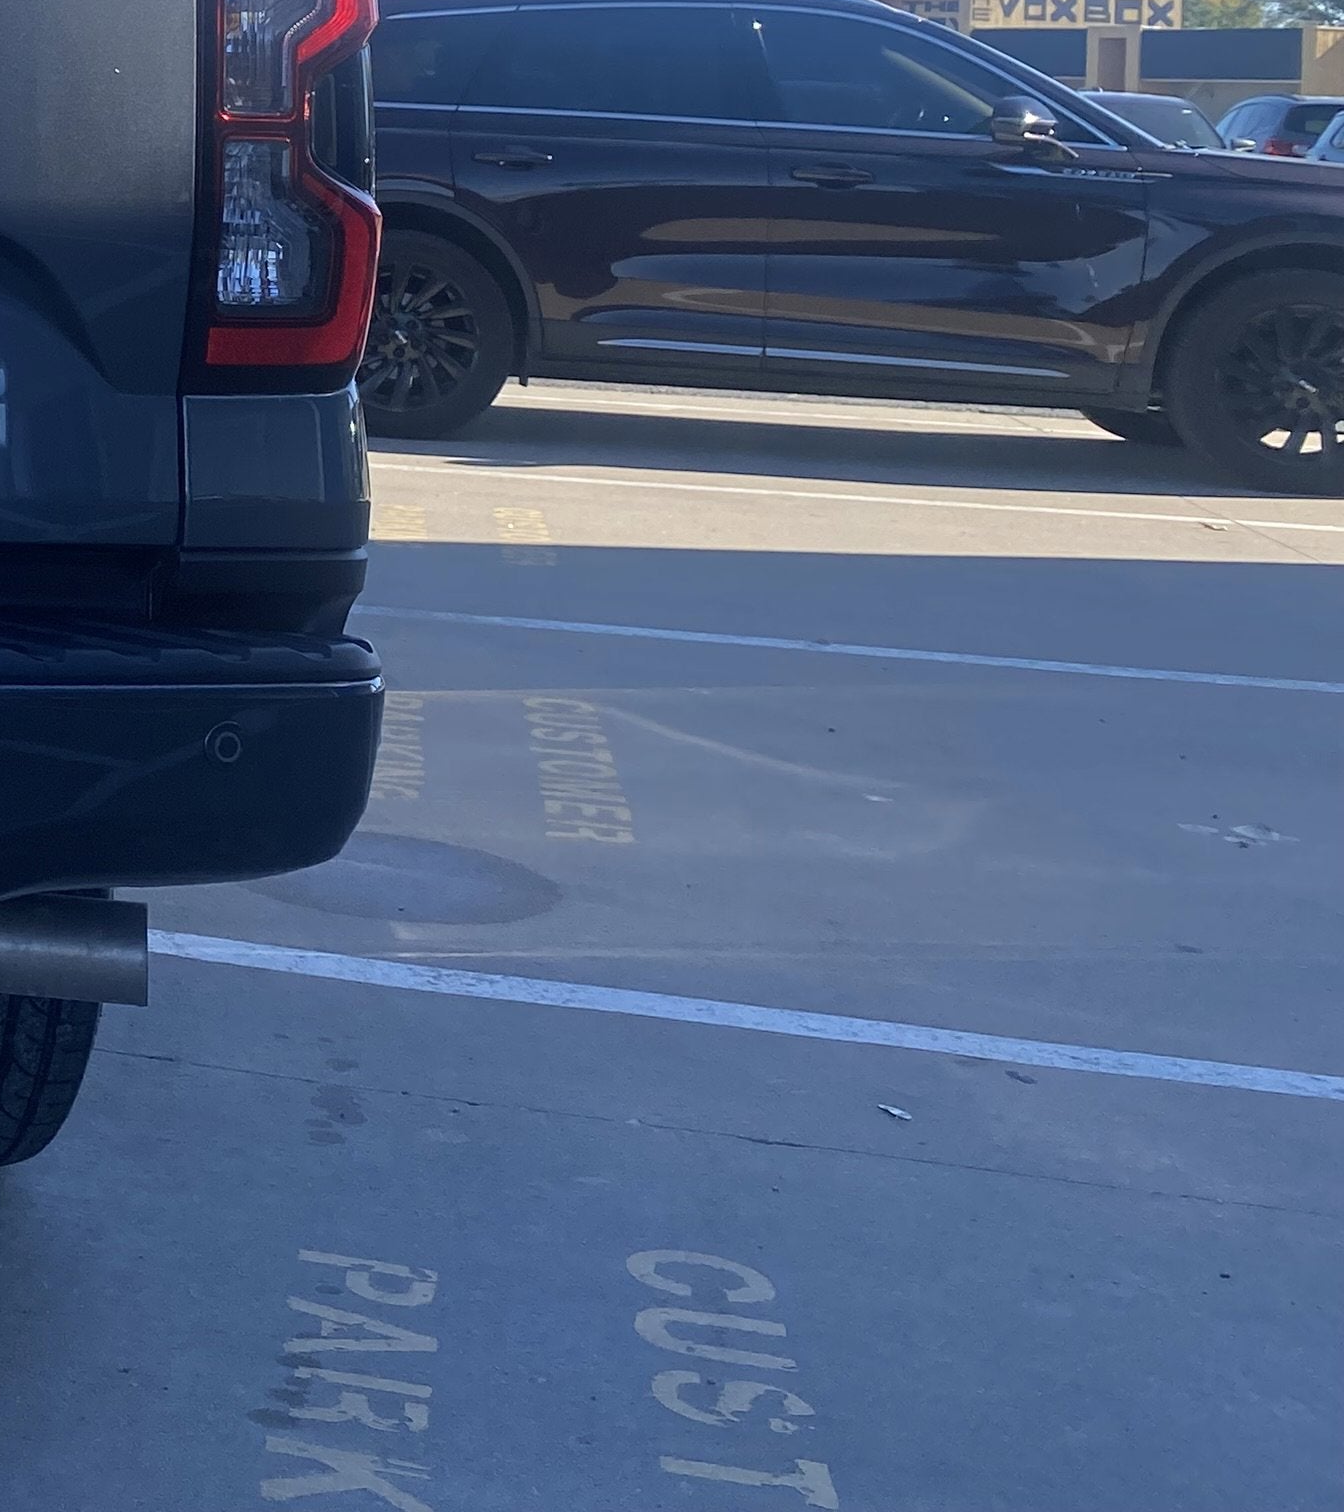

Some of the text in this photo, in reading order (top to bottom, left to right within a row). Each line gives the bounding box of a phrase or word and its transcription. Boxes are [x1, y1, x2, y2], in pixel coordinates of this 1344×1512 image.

[522, 696, 636, 844] CUSTOMER
[261, 1248, 440, 1512] PARK
[626, 1248, 839, 1510] CUST
